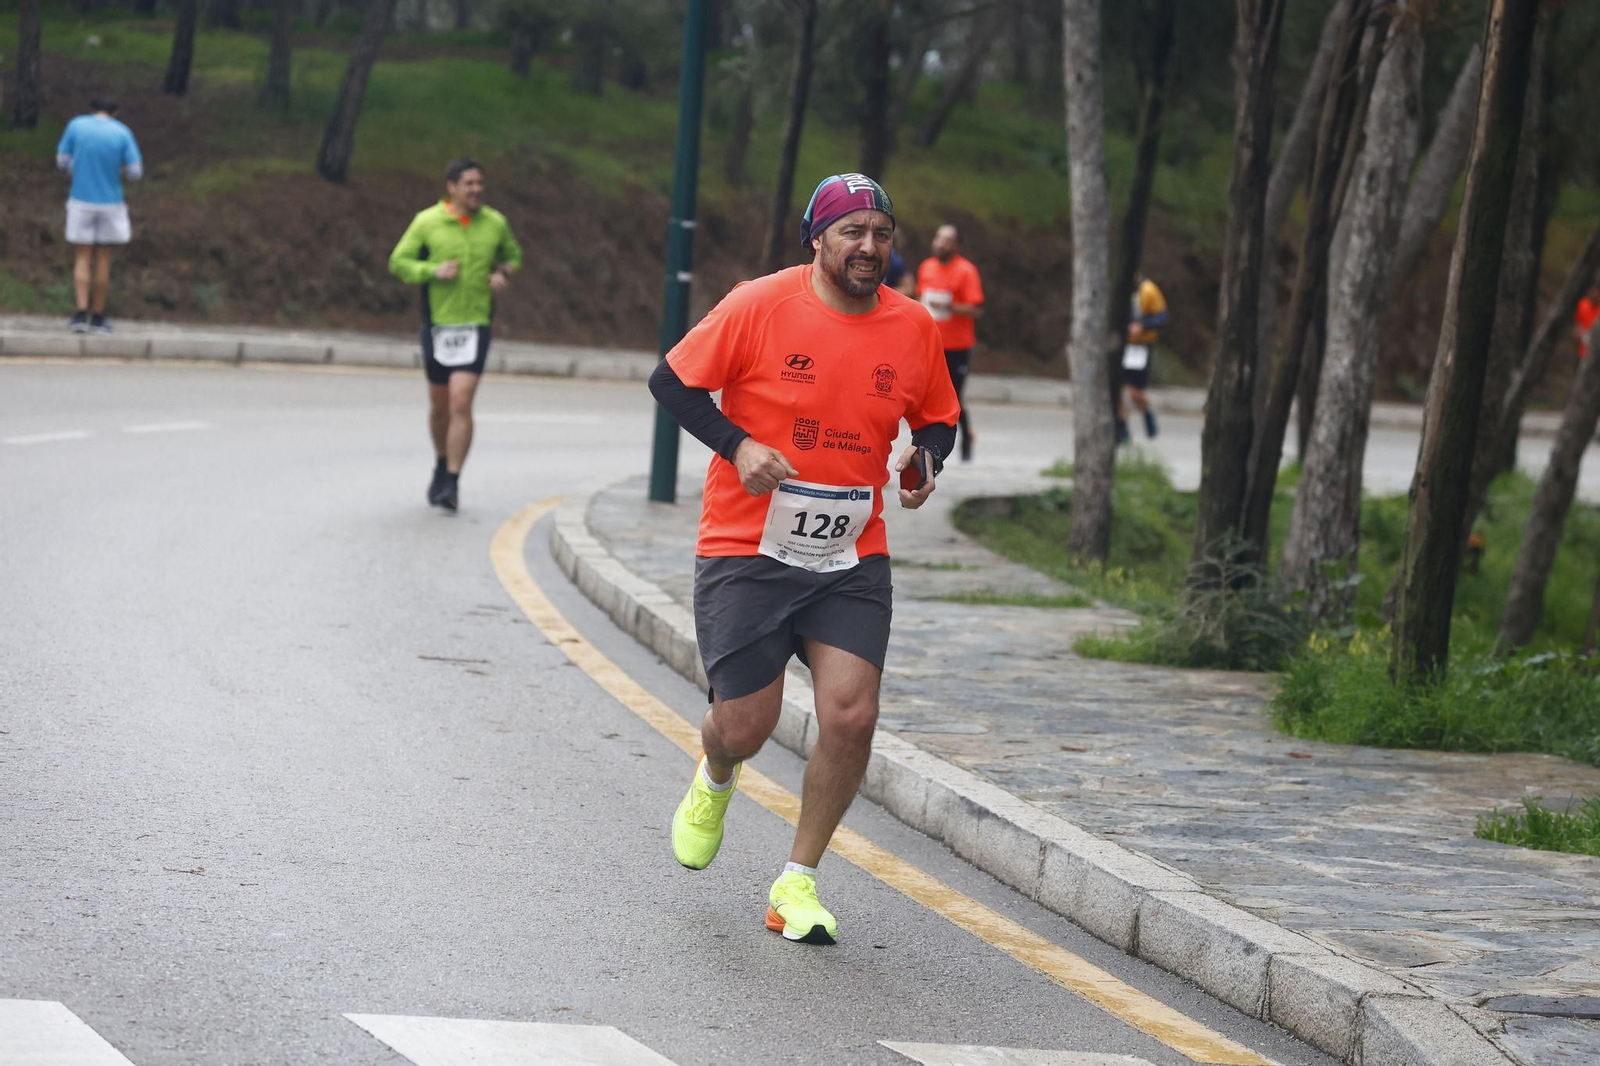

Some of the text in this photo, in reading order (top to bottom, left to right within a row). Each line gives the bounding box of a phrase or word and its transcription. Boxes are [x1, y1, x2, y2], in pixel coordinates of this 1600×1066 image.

[780, 370, 816, 380] HYUNDAI
[824, 428, 861, 440] Ciudad
[822, 440, 872, 455] de Málaga
[791, 511, 850, 540] 128
